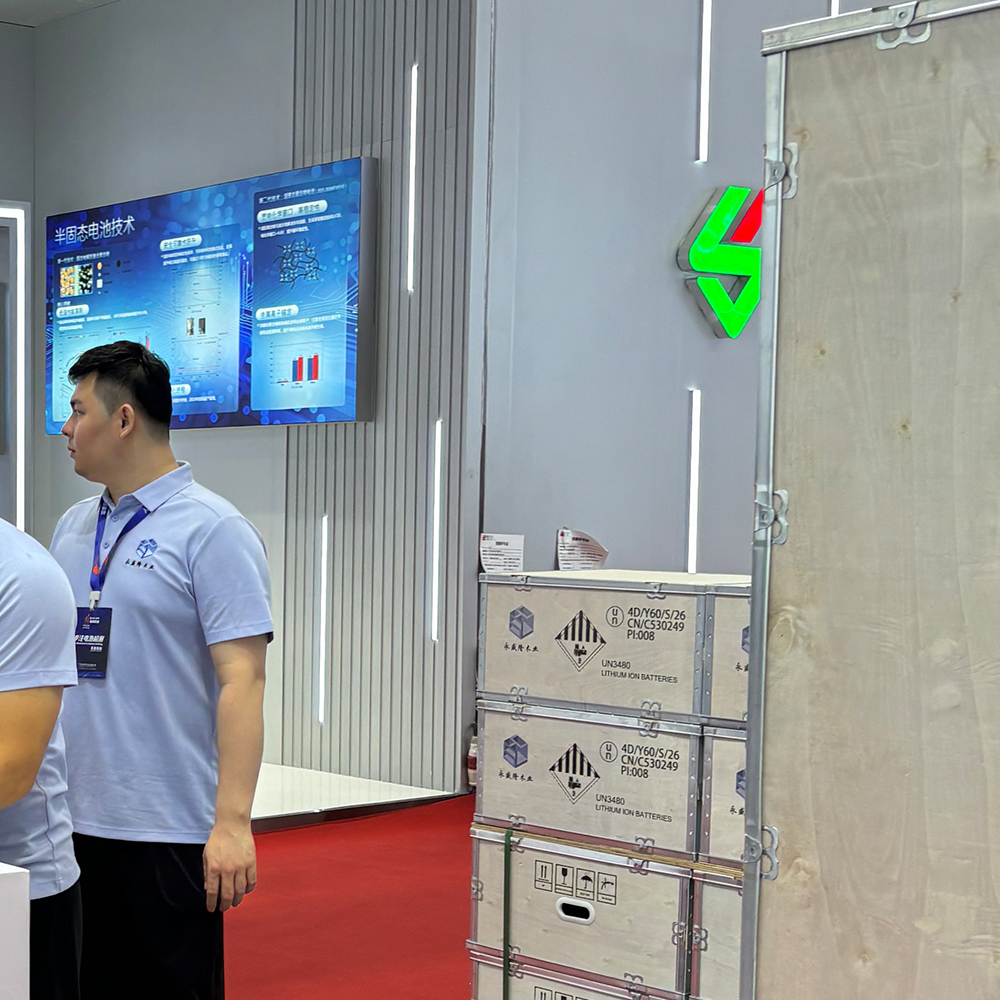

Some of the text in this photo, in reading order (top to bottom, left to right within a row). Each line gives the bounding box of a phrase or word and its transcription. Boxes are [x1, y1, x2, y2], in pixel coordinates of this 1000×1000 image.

[54, 215, 136, 245] 半固态电池技术
[627, 607, 686, 621] 4D/Y60/S/26
[627, 618, 685, 631] CN/C530249
[626, 629, 655, 641] PI:008
[601, 659, 631, 670] UN3480
[601, 670, 679, 683] LITHIUM ION BATTERIES
[621, 744, 680, 761] 4D/Y60/S/26
[620, 755, 679, 771] CN/C530249
[620, 766, 649, 779] PI:008
[595, 794, 625, 805] UN3480
[595, 804, 672, 822] LITHIUM ION BATTERIES
